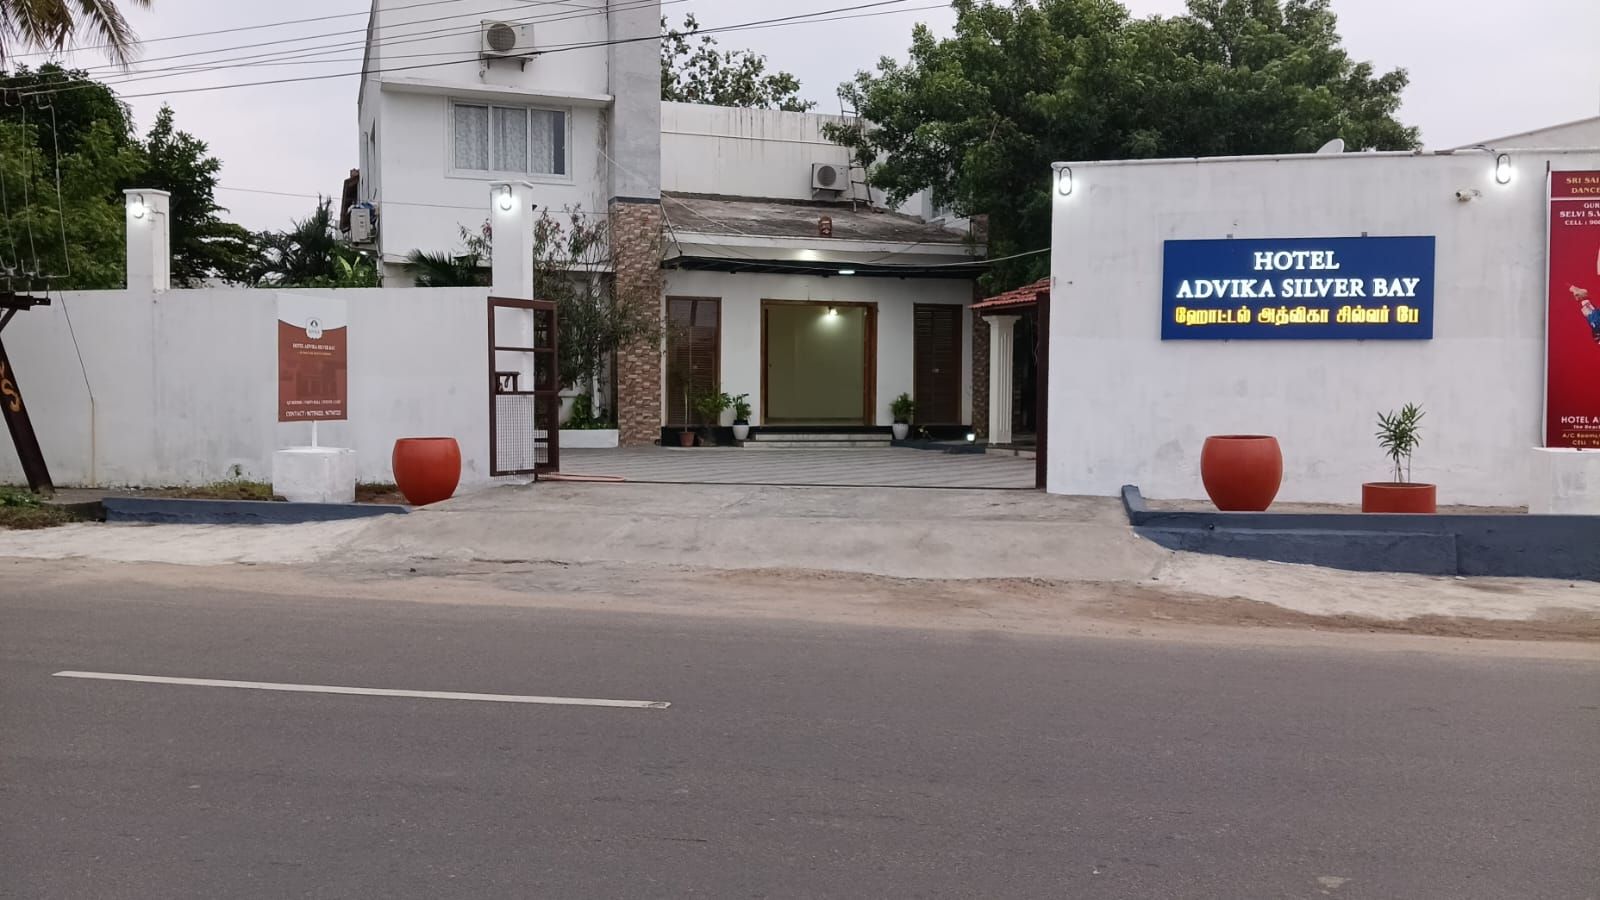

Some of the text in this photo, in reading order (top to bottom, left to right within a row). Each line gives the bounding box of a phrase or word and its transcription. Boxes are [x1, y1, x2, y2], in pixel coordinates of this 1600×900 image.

[1560, 210, 1585, 218] SELVI
[1253, 251, 1340, 271] HOTEL
[1176, 277, 1420, 299] ADVIKA SILVER BAY
[1175, 305, 1251, 326] ஹோட்டல்
[1396, 305, 1419, 323] பே
[1561, 416, 1589, 424] HOTEL
